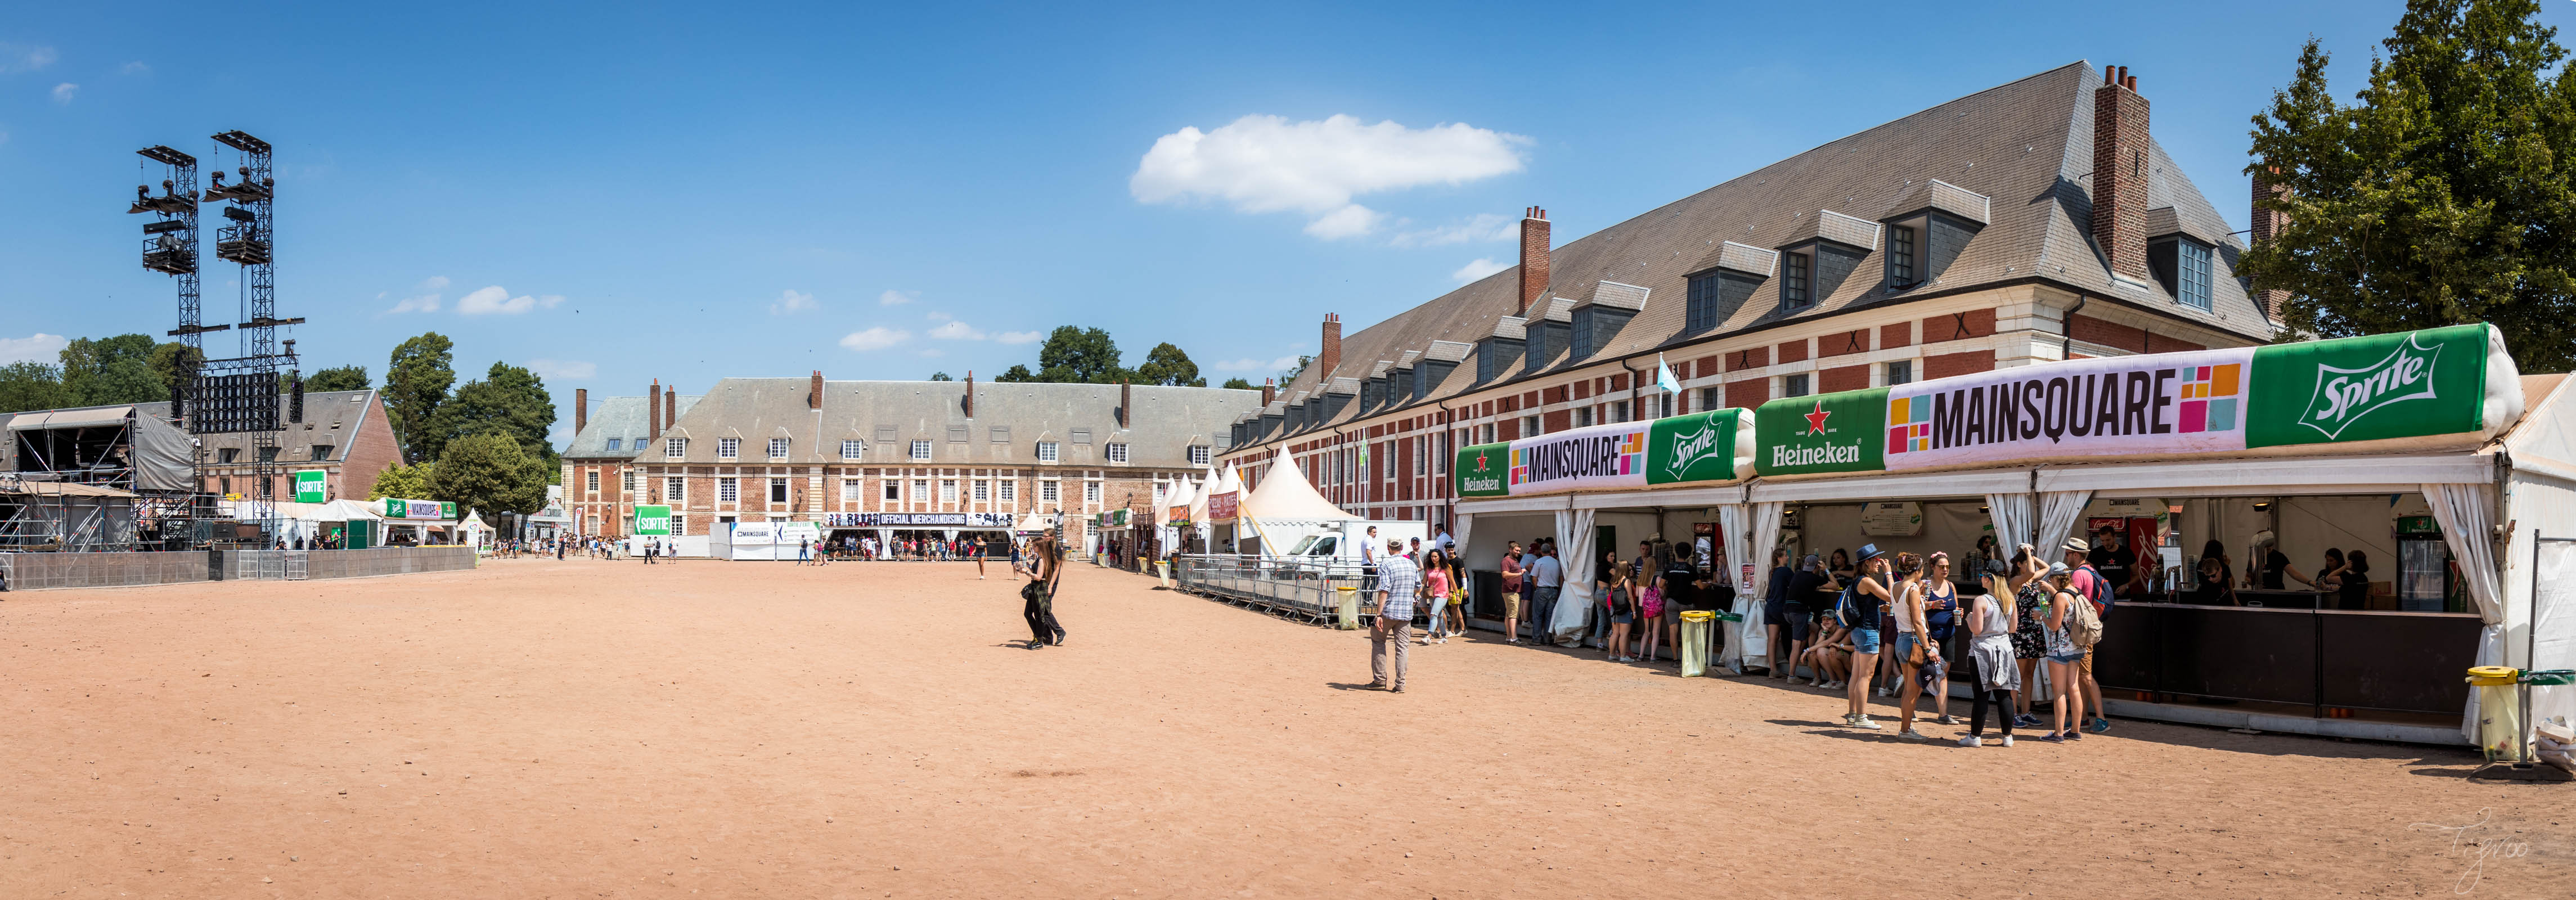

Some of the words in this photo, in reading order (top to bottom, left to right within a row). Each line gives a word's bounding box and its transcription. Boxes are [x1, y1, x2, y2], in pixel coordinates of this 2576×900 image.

[2316, 348, 2424, 422] Sprite
[1932, 368, 2176, 449] MAINSQUARE
[1672, 424, 1715, 470] Sprite
[1772, 442, 1859, 467] Heineken
[1528, 435, 1620, 481] MAINSQUARE
[300, 481, 323, 493] SORTIE
[1464, 476, 1499, 491] Heineken
[412, 503, 436, 516] MAINSQUARE
[881, 514, 910, 524] OFFICIAL
[911, 514, 965, 524] MERCHANDISING
[641, 517, 668, 530] SORTIE
